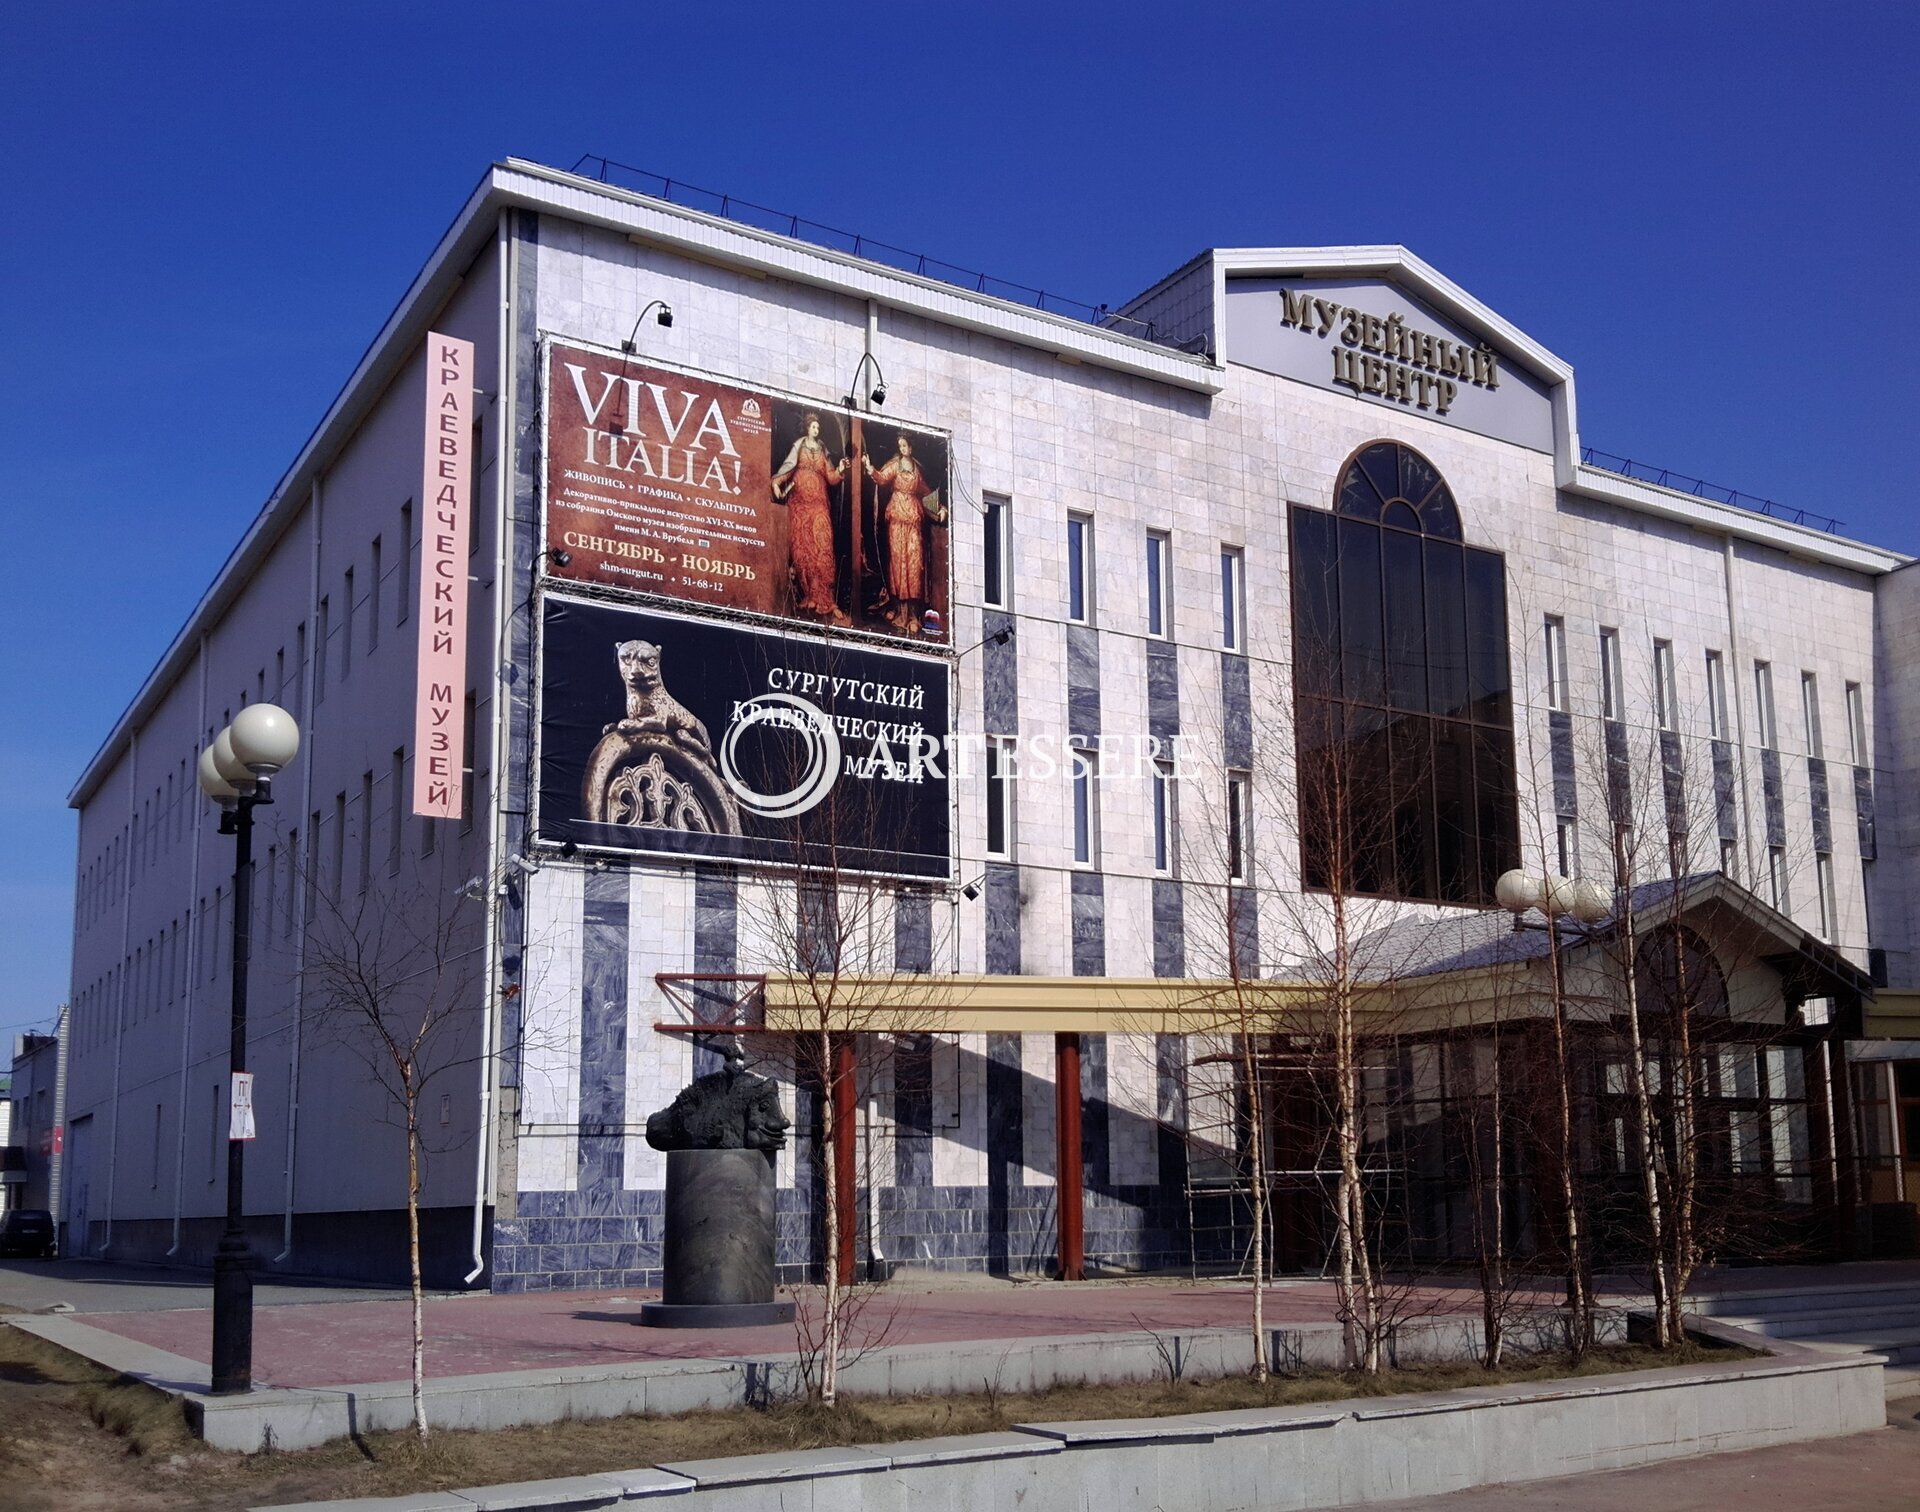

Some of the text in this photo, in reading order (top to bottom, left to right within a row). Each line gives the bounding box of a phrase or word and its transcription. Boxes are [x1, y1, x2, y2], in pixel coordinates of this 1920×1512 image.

[1279, 288, 1500, 389] МУЗЕЙНЫЙ
[1332, 346, 1458, 415] ЦЕНТР
[563, 362, 740, 458] VIVA
[583, 426, 742, 496] ITALIA!
[564, 469, 756, 517] ЖИВОПИСЬ ГРАФИКА СКУЛЬПТУРА
[555, 499, 565, 508] из
[566, 501, 605, 516] собрания
[606, 508, 641, 523] Омского
[642, 517, 665, 528] музея
[666, 520, 732, 541] изобразительных
[614, 524, 640, 535] имени
[662, 532, 694, 546] Врубеля
[735, 524, 757, 534] веков
[428, 345, 459, 805] КРАЕВЕДЧЕСКИЙ МУЗЕЙ
[563, 530, 665, 564] СЕНТЯБРЬ
[682, 553, 756, 581] НОЯБРЬ
[600, 560, 724, 592] shm-surgut.ru 51-68-12
[767, 667, 925, 709] СУРГУТСКИЙ
[731, 700, 925, 747] КРАЕВЕДЧЕСКИЙ
[844, 755, 925, 784] МУЗЕЙ
